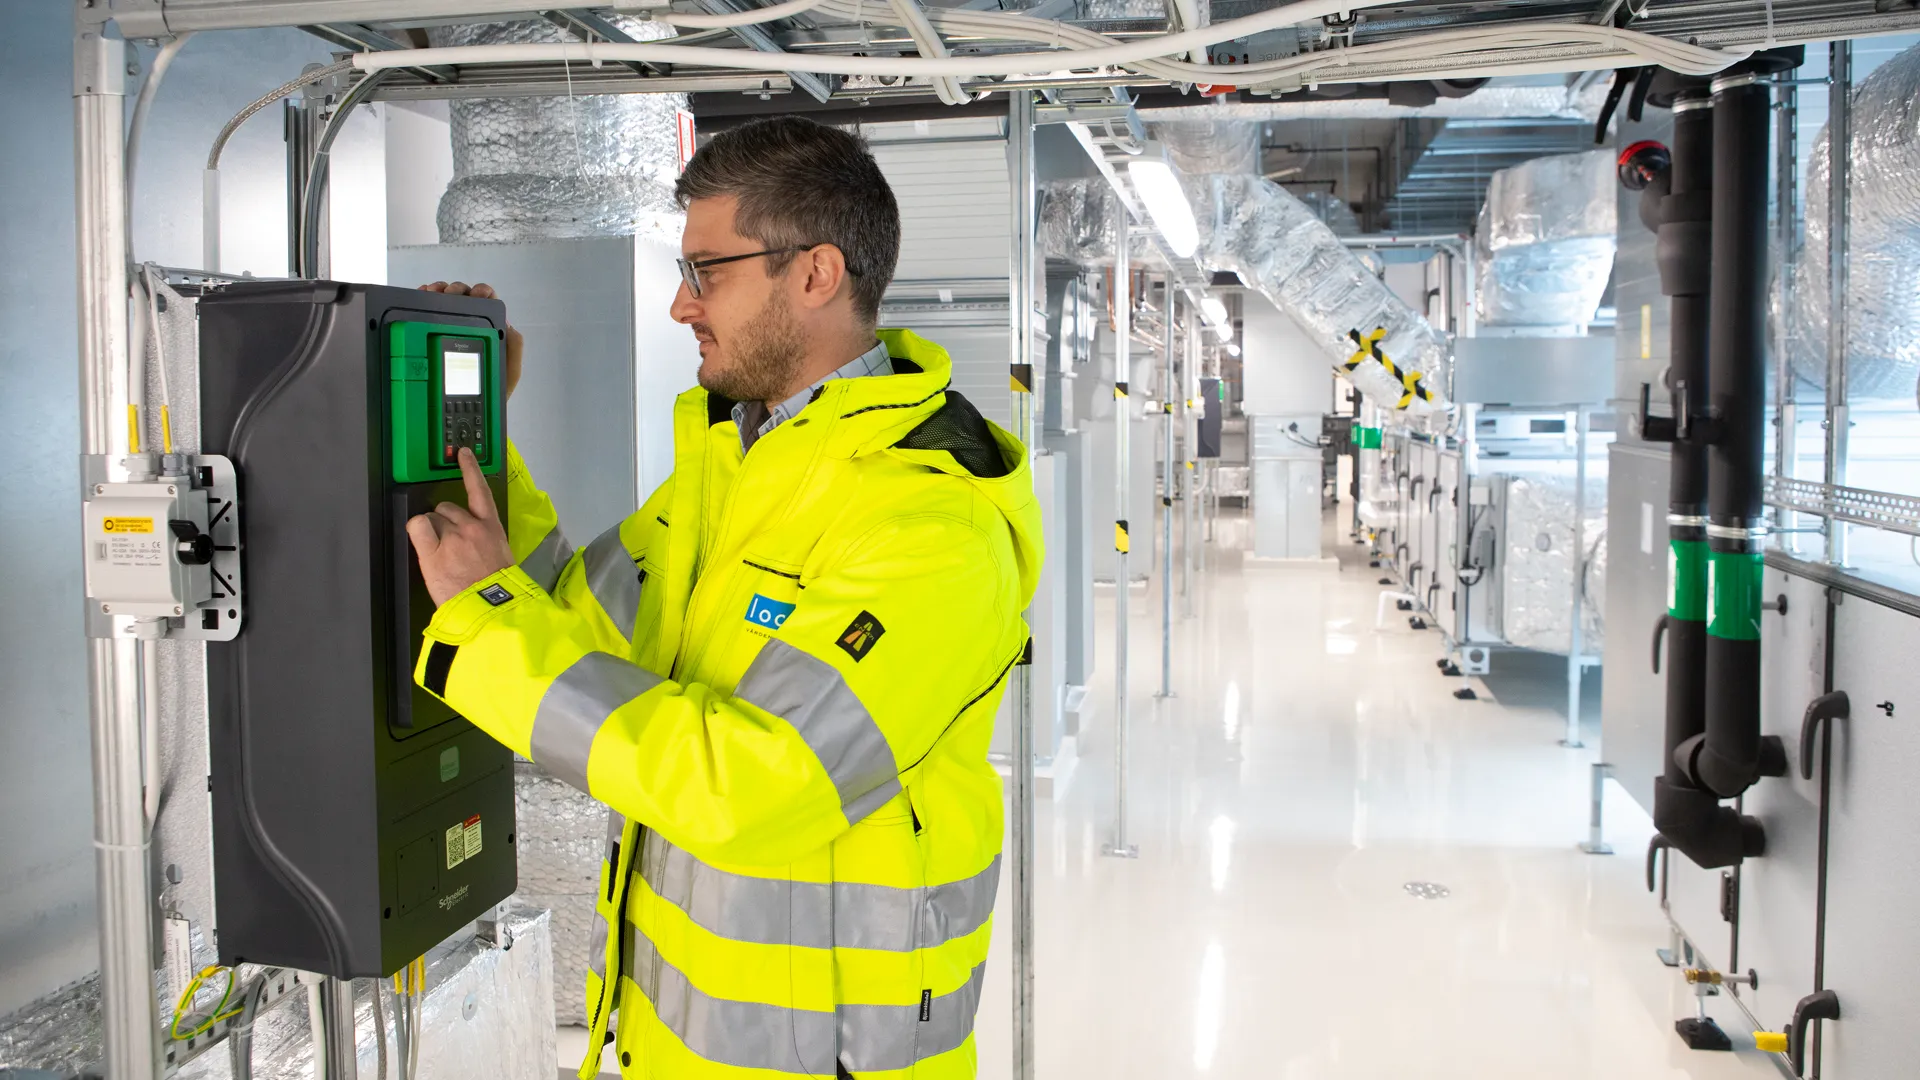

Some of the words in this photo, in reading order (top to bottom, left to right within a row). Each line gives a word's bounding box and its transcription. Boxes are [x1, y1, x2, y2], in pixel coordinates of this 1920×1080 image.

[1258, 51, 1290, 61] WIBE
[750, 597, 787, 627] loc
[439, 885, 469, 911] Schneider
